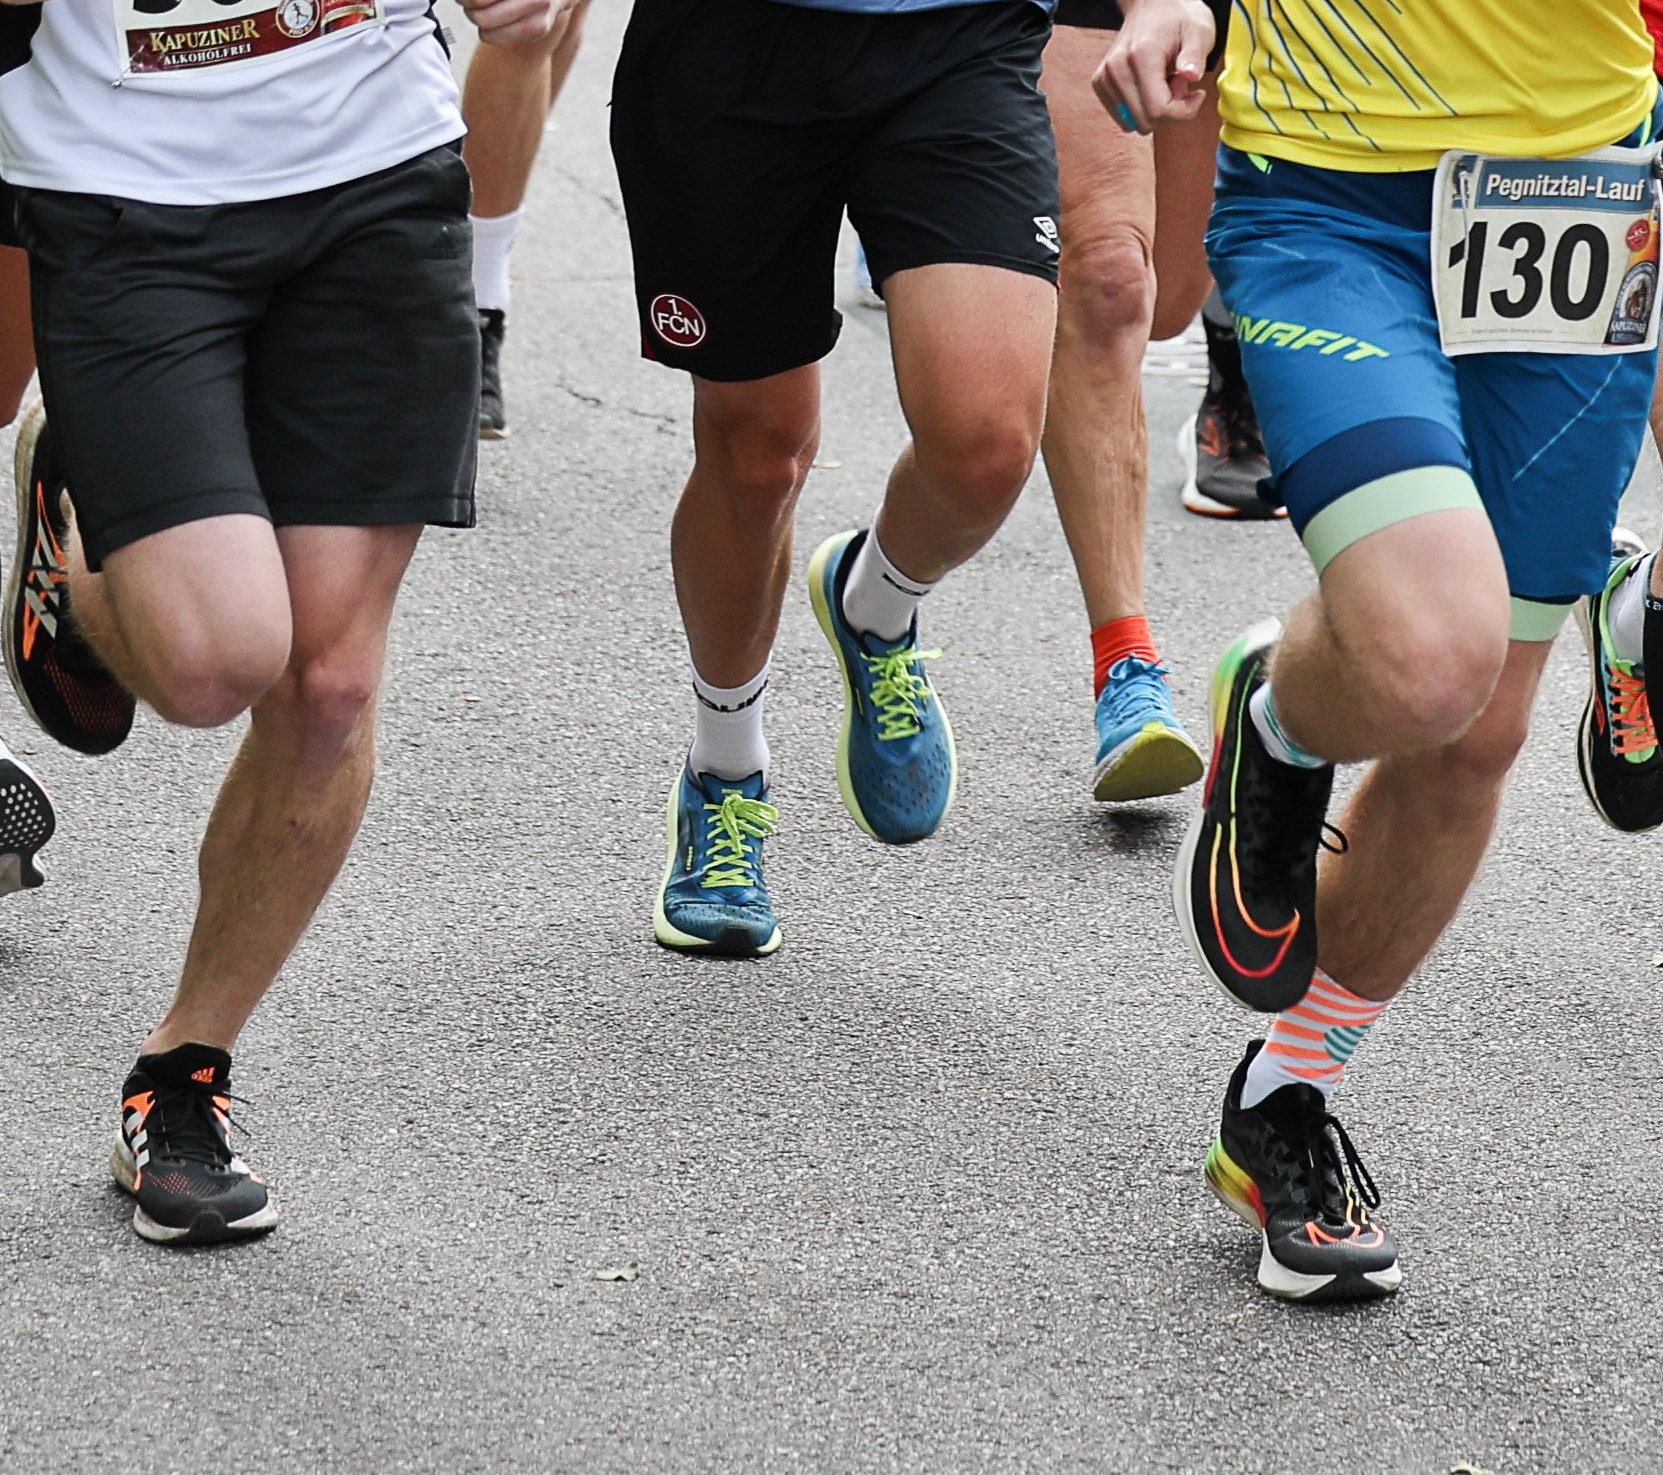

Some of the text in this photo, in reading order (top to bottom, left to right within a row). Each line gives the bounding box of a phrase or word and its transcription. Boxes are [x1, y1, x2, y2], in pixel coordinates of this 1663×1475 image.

[149, 18, 261, 53] KAPUZINER
[163, 42, 252, 66] ALKOHOLFREI
[1486, 173, 1646, 202] Pegnitztal-Lauf
[1448, 221, 1610, 321] 130
[667, 298, 683, 316] 1.
[657, 311, 701, 337] FCN
[1232, 315, 1391, 363] NAFIT
